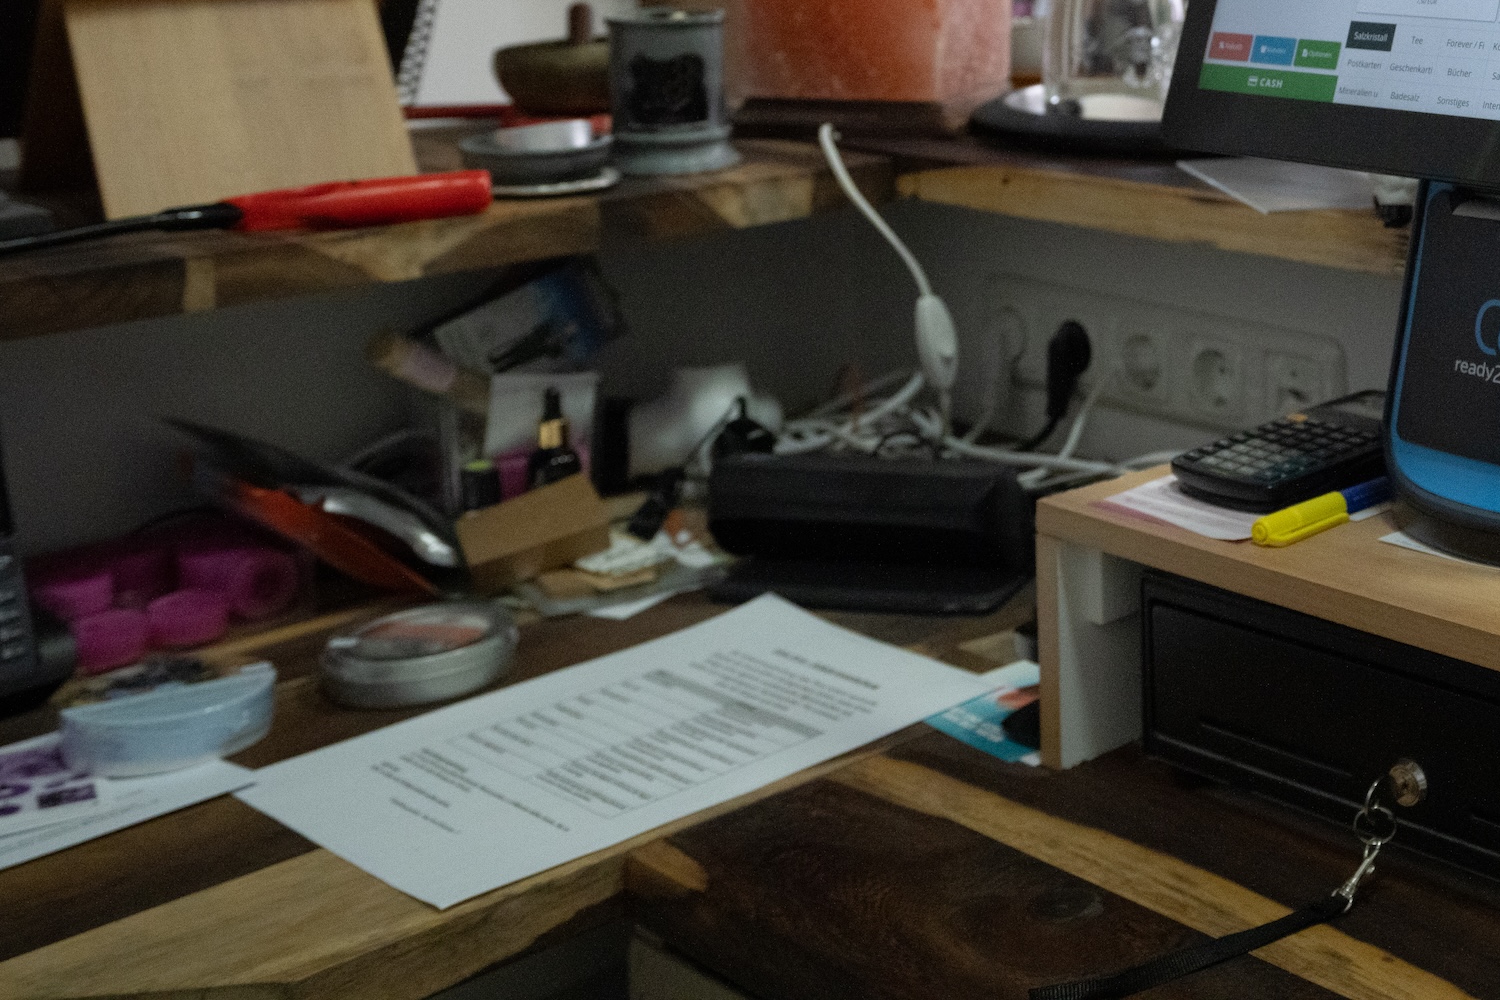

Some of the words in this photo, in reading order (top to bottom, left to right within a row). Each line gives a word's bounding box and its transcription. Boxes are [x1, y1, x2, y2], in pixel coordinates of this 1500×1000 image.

[1411, 36, 1423, 44] Tee
[1447, 68, 1472, 77] Bücher
[1259, 78, 1283, 88] CASH
[1437, 96, 1469, 108] Sonstiges
